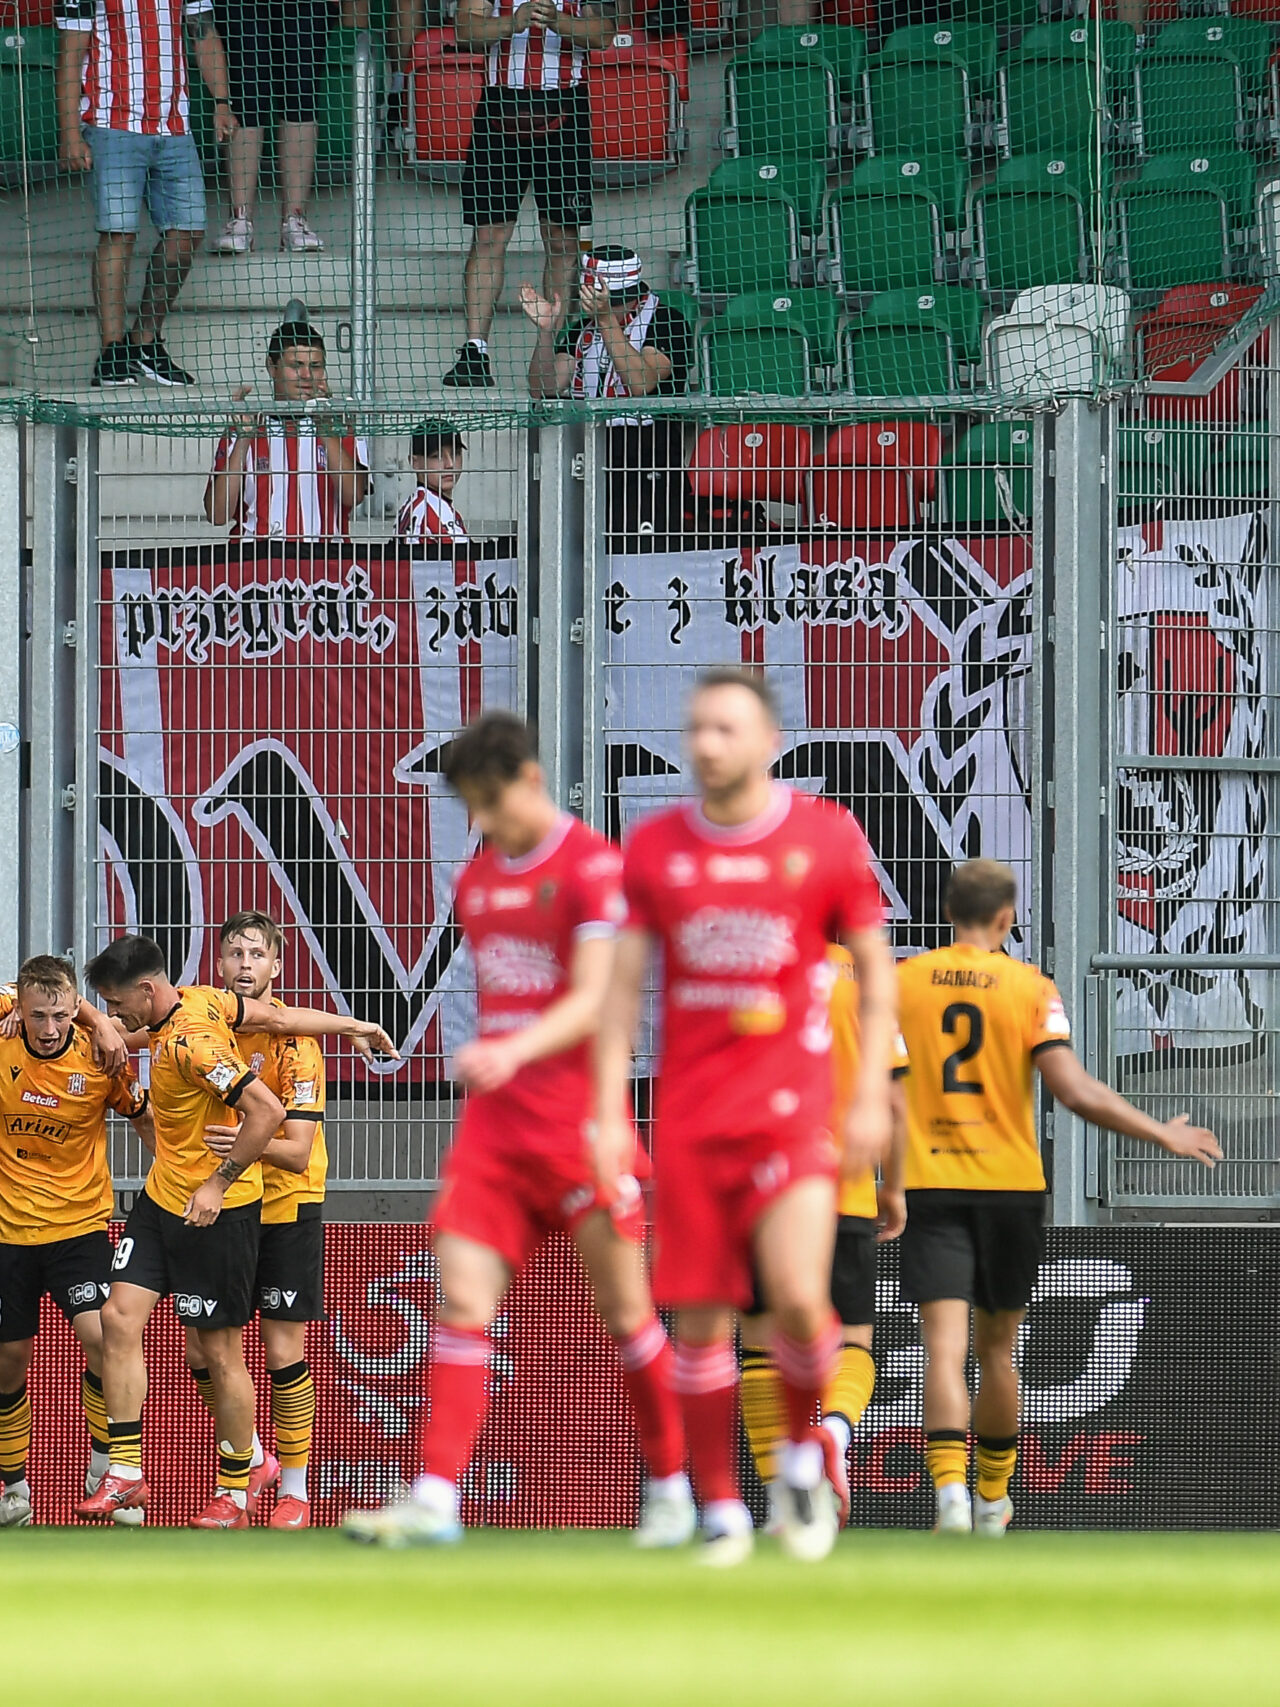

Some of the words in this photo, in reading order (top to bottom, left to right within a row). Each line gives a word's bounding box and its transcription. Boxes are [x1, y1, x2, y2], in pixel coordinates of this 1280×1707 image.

[942, 1001, 985, 1095] 2
[22, 1091, 59, 1108] Betclic
[9, 1117, 66, 1139] Arini
